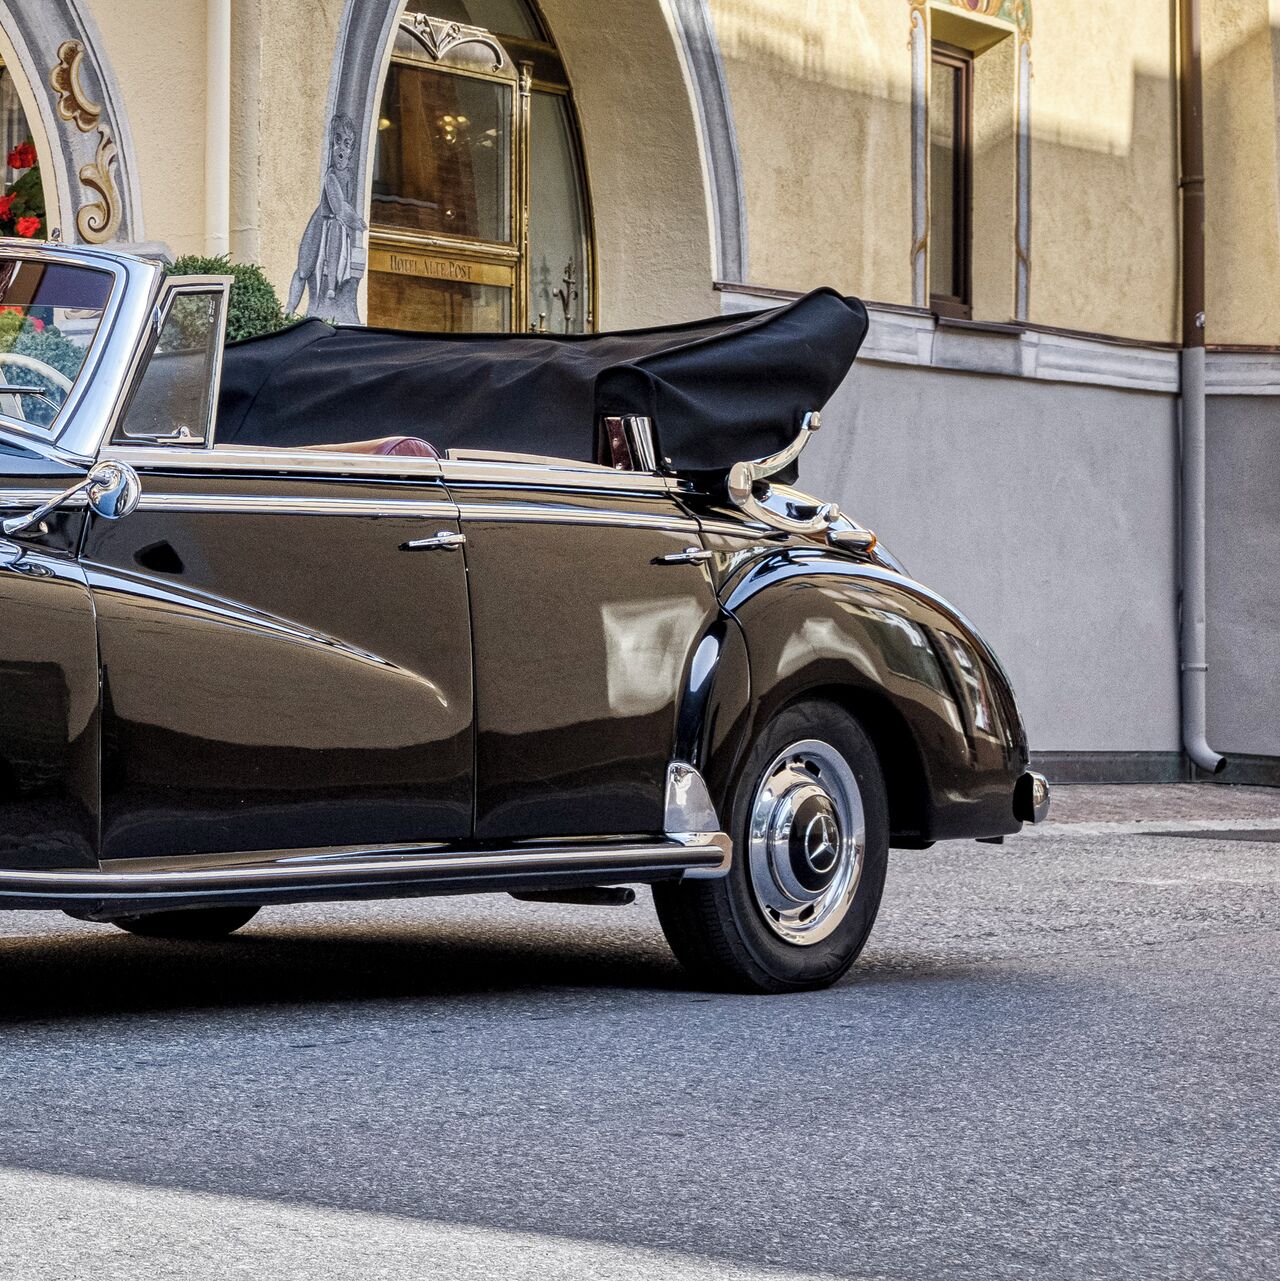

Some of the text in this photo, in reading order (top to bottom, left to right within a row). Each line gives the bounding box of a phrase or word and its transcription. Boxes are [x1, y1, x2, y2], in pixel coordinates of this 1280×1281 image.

[390, 255, 473, 280] HOTEL ALTE POST
